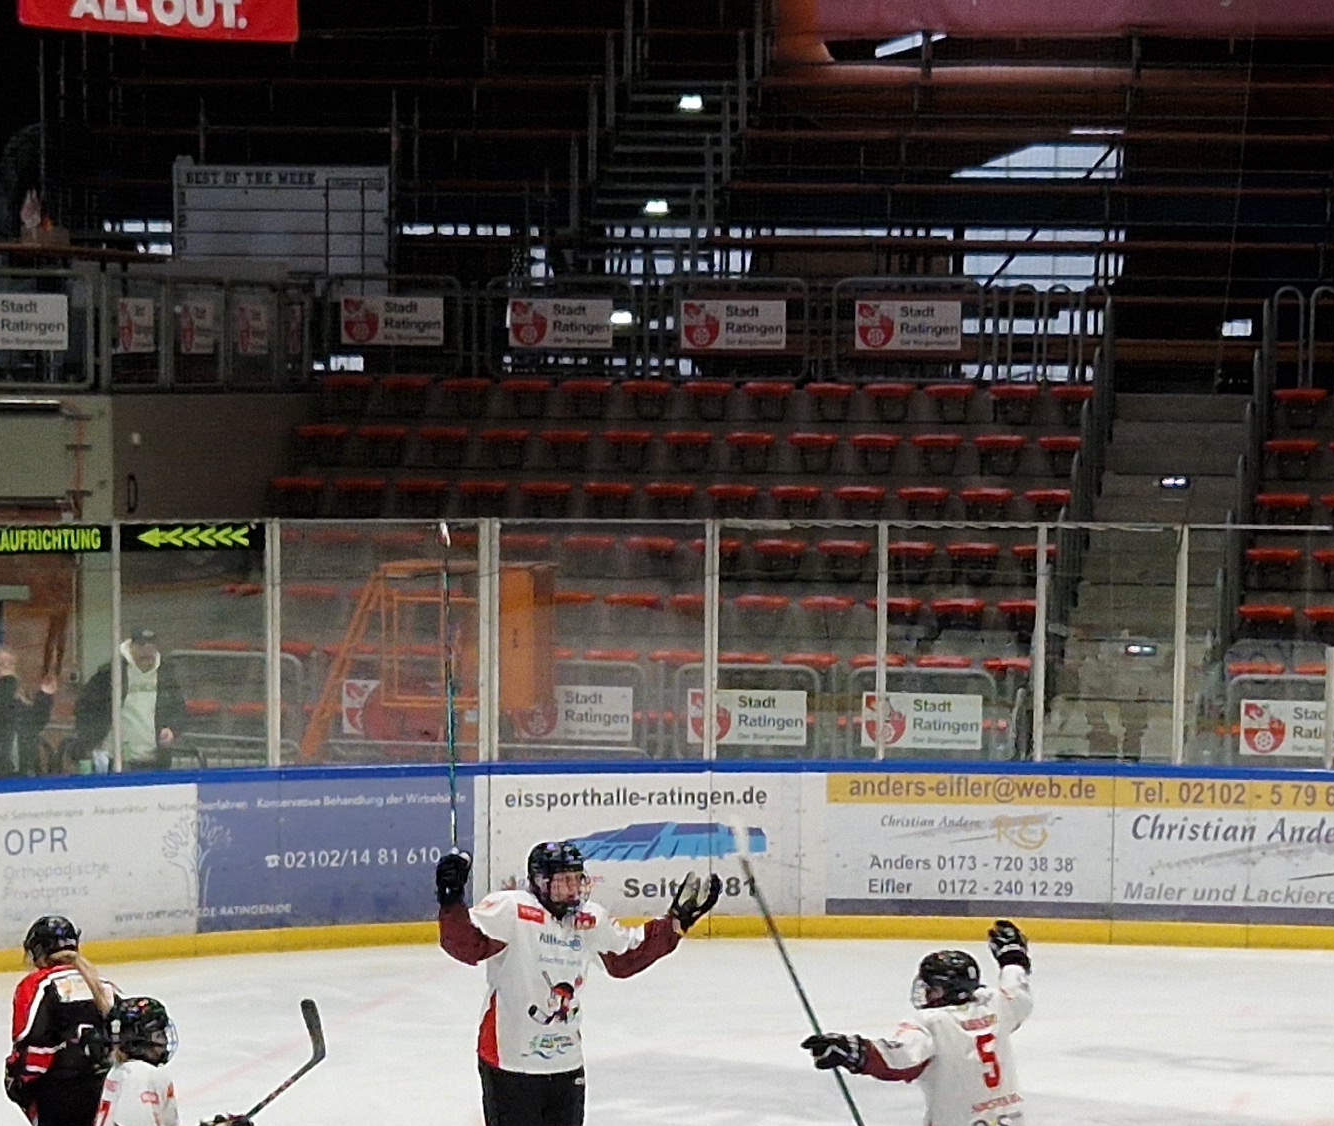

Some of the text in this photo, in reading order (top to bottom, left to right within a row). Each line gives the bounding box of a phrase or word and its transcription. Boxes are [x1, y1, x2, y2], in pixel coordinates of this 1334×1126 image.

[186, 172, 316, 185] BEST OF THE WEEK
[0, 300, 38, 313] Stadt
[384, 302, 417, 313] Stadt
[553, 304, 586, 315] Stadt
[726, 306, 759, 317] Stadt
[900, 306, 934, 317] Stadt
[1, 319, 65, 335] Ratingen
[384, 319, 441, 332] Ratingen
[553, 321, 610, 334] Ratingen
[726, 322, 783, 336] Ratingen
[900, 322, 958, 336] Ratingen
[564, 691, 603, 704] Stadt
[738, 695, 776, 708] Stadt
[913, 699, 951, 712] Stadt
[564, 710, 630, 725] Ratingen
[738, 715, 804, 729] Ratingen
[913, 718, 979, 732] Ratingen
[849, 776, 1097, 802] anders-eifler@web.de
[1132, 781, 1169, 804] Tel.
[1179, 783, 1246, 805] 02102
[1271, 784, 1282, 805] 5
[1291, 785, 1317, 807] 79
[505, 786, 767, 812] eissporthalle-ratingen.de
[1132, 814, 1257, 842] Christian
[4, 826, 68, 855] OPR
[284, 847, 441, 869] 02102/14 81 610
[869, 855, 931, 870] Anders
[937, 855, 977, 870] 0173
[995, 856, 1023, 871] 720
[1029, 856, 1048, 872] 38
[1054, 857, 1073, 872] 38
[868, 878, 912, 895] Eifler
[938, 879, 977, 895] 0172
[994, 880, 1023, 896] 240
[1031, 880, 1049, 896] 12
[1053, 881, 1073, 897] 29
[1123, 882, 1185, 901] Maler
[1194, 883, 1237, 902] und
[975, 1033, 1001, 1088] 5
